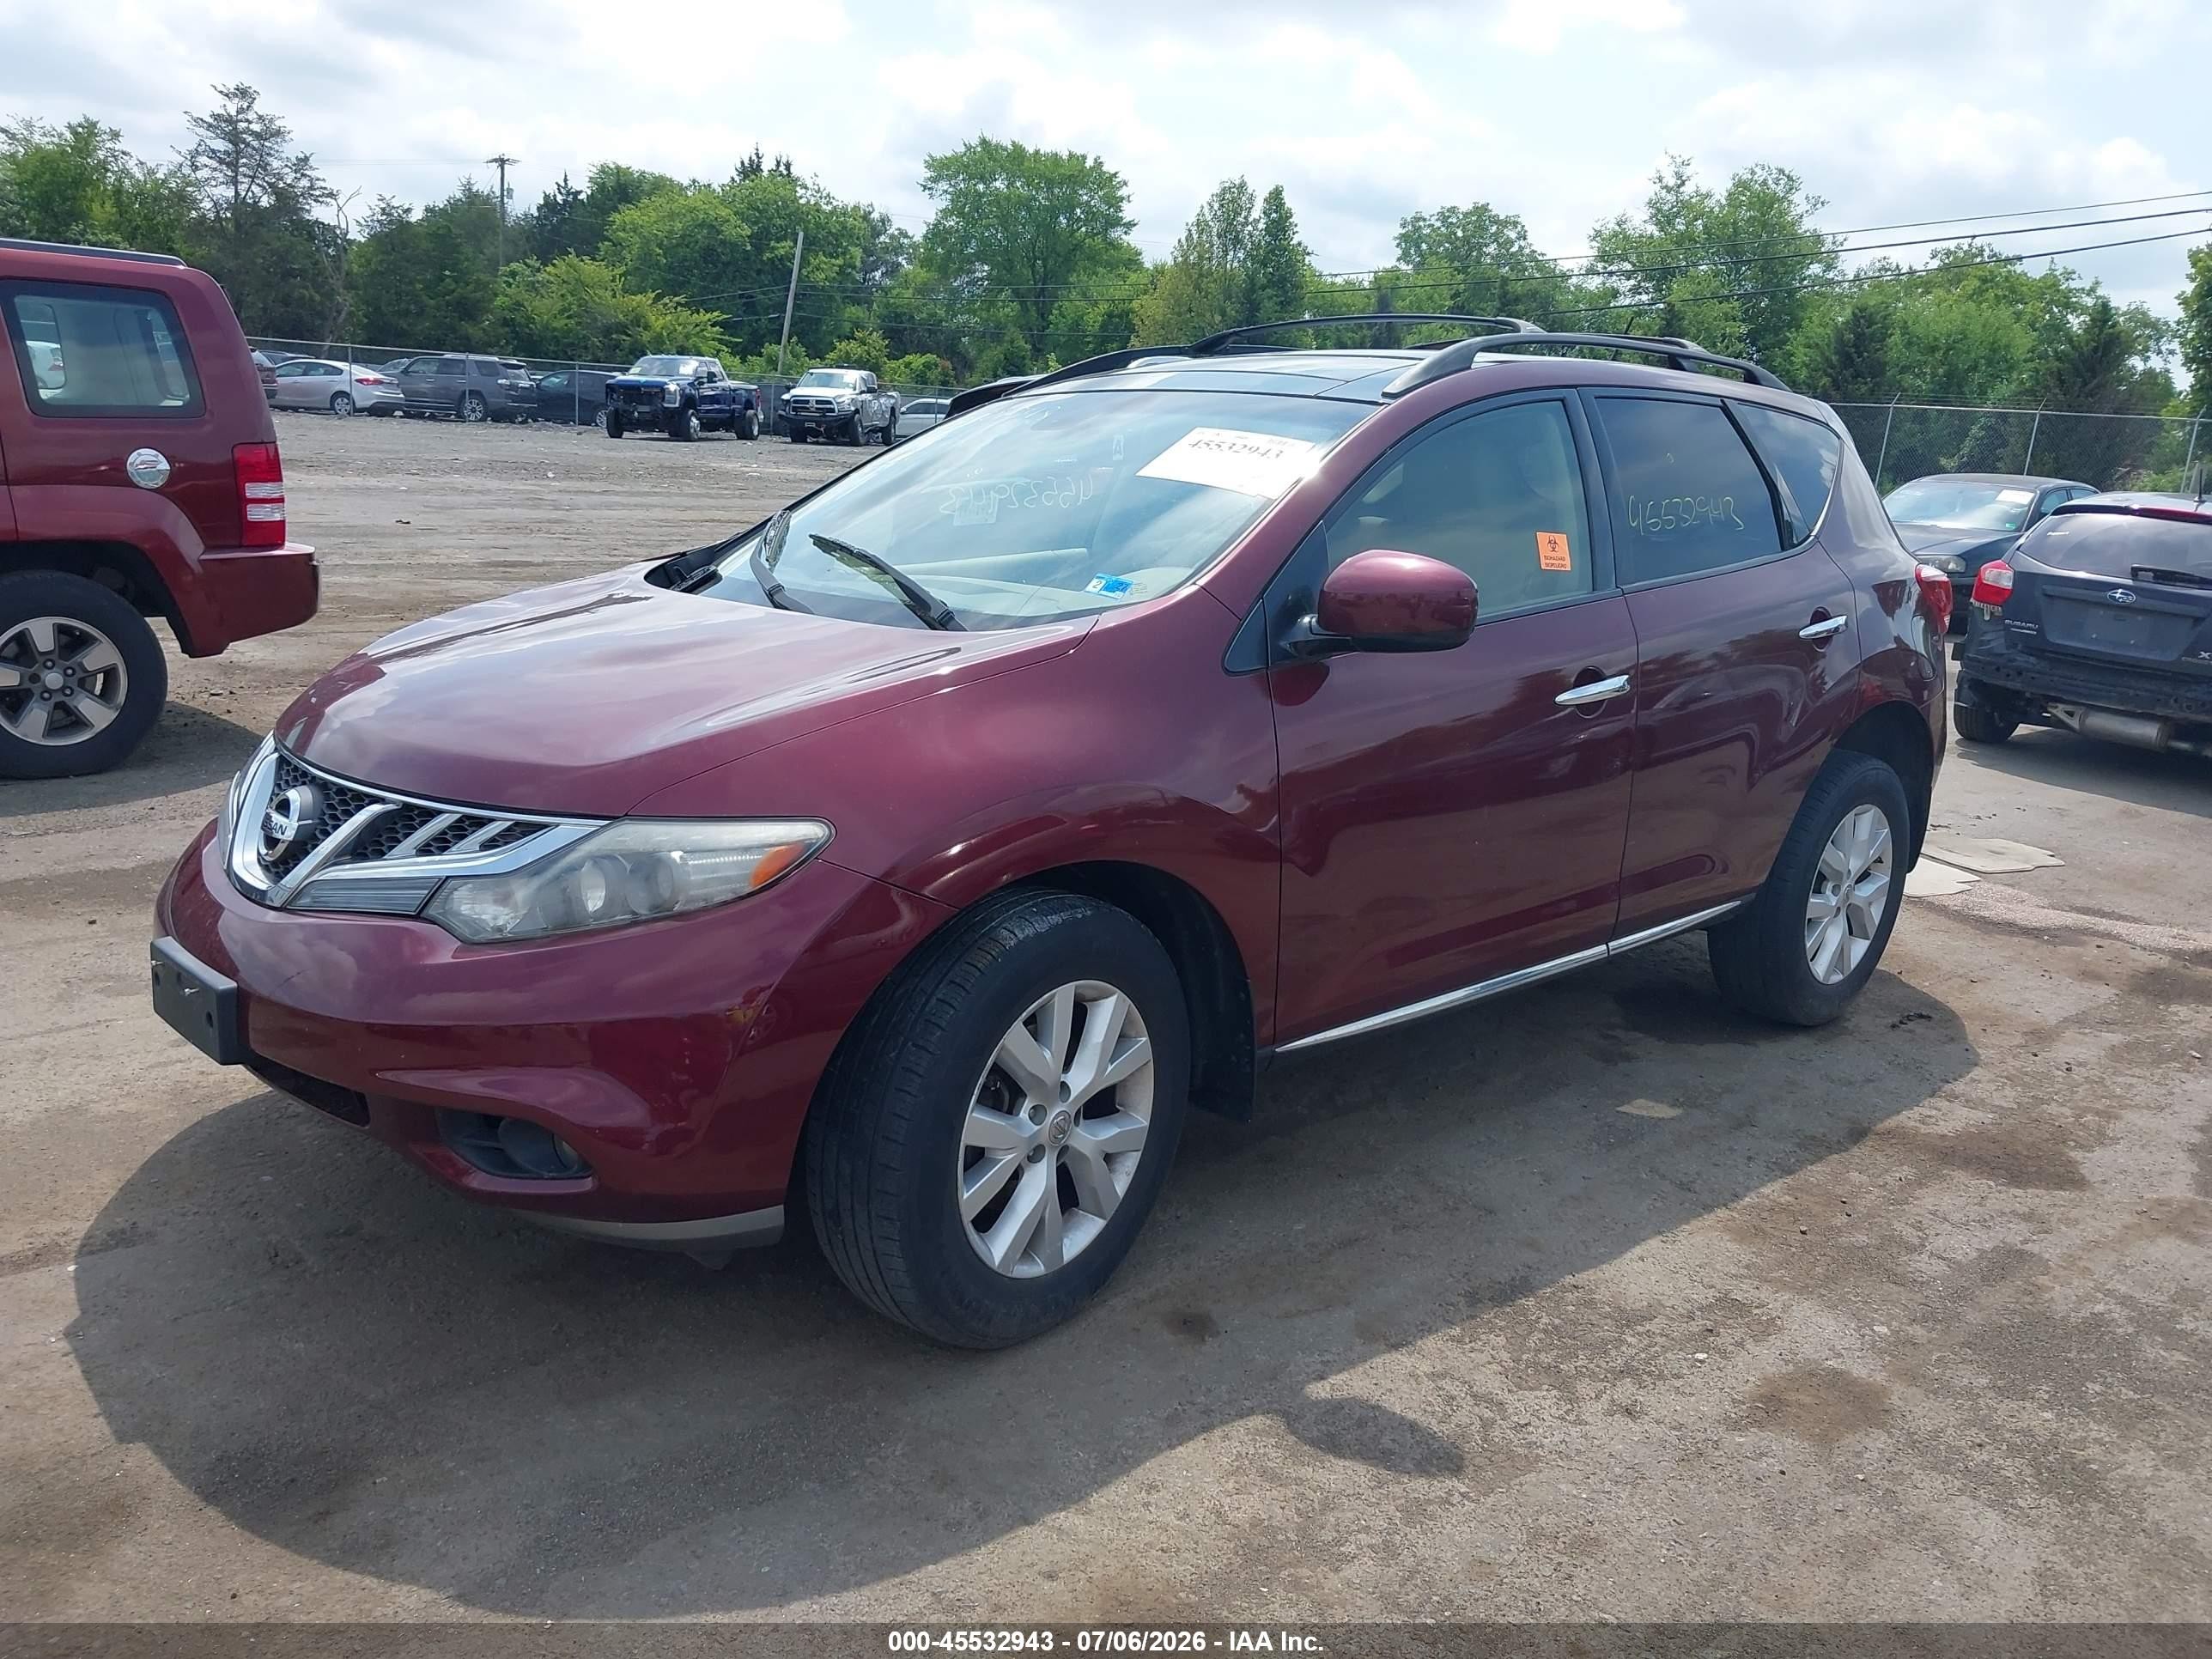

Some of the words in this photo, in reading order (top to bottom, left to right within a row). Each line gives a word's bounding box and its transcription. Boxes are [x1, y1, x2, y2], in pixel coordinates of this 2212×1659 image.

[1188, 440, 1284, 459] 45532943
[1628, 495, 1745, 536] 45532943
[1092, 580, 1103, 589] 2
